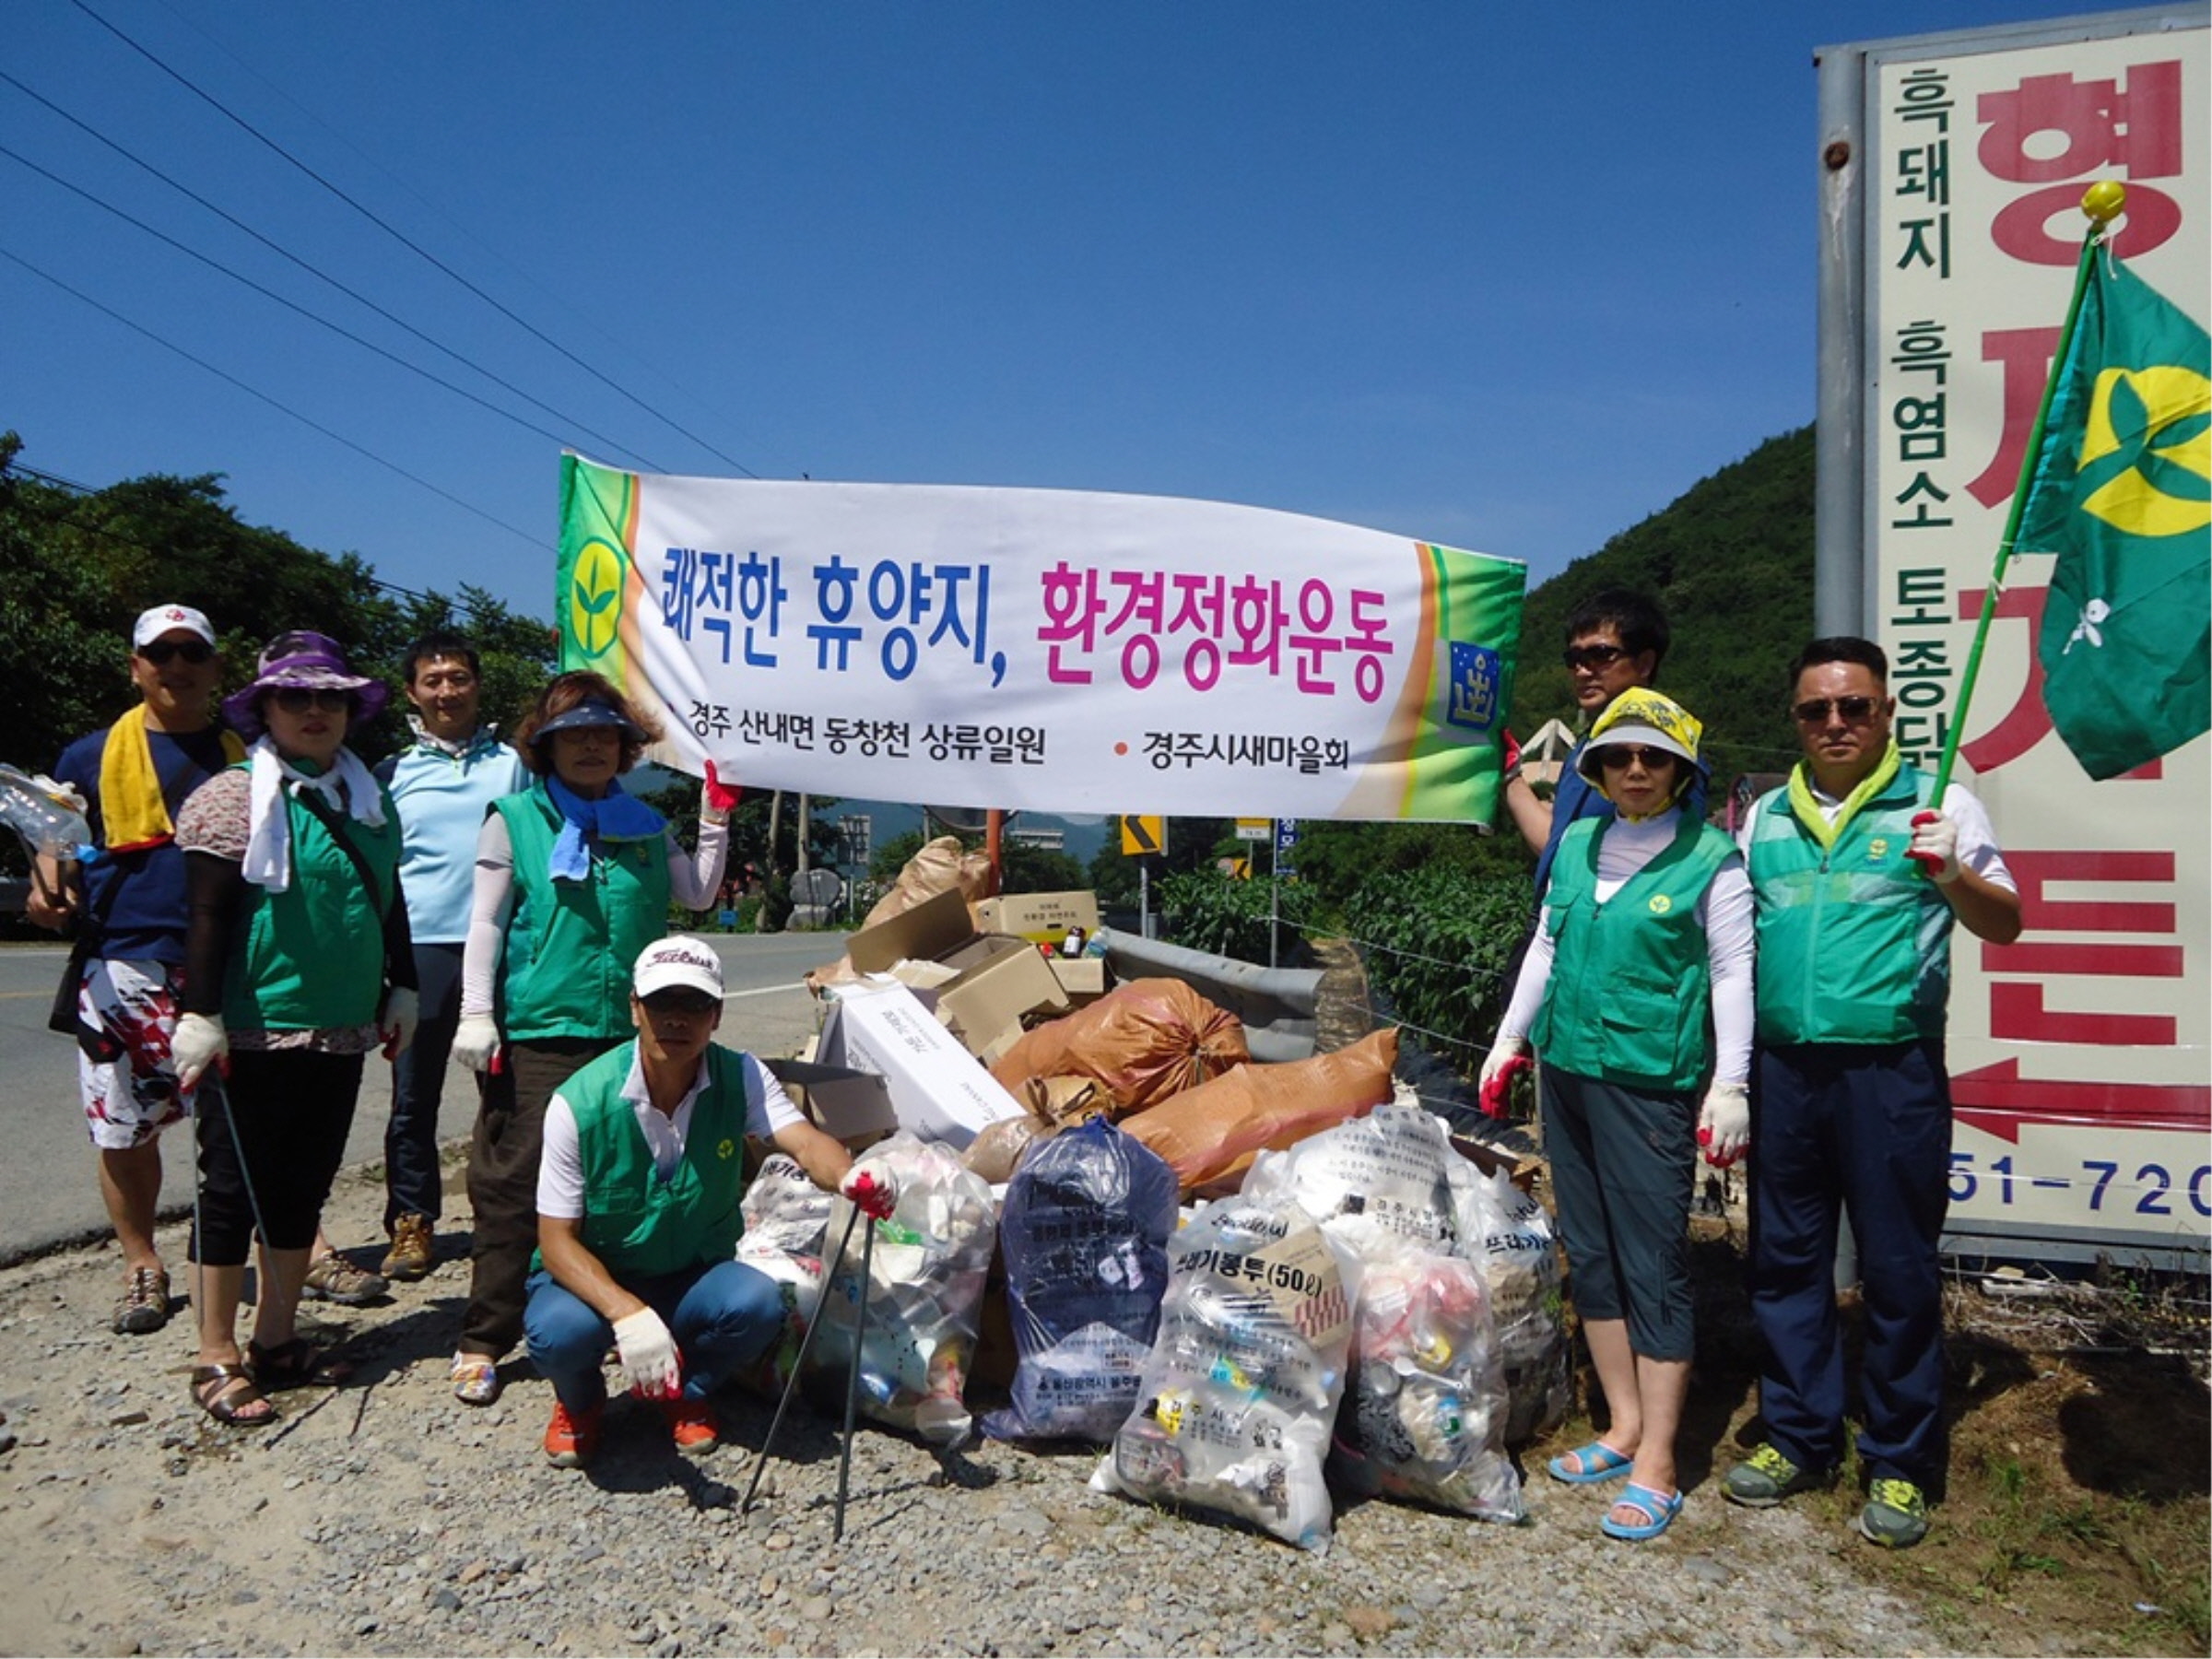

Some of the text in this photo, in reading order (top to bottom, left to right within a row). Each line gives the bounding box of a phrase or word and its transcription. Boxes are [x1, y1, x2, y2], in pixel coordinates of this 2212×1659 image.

[1893, 69, 1954, 278] 흑돼지
[1891, 320, 1953, 529] 흑염소
[663, 547, 1394, 703] 쾌적한 휴양지, 환경정화운동
[690, 699, 1046, 764] 경주 산내면 동창천 상류일원
[1142, 733, 1349, 773] 경주시새마을회
